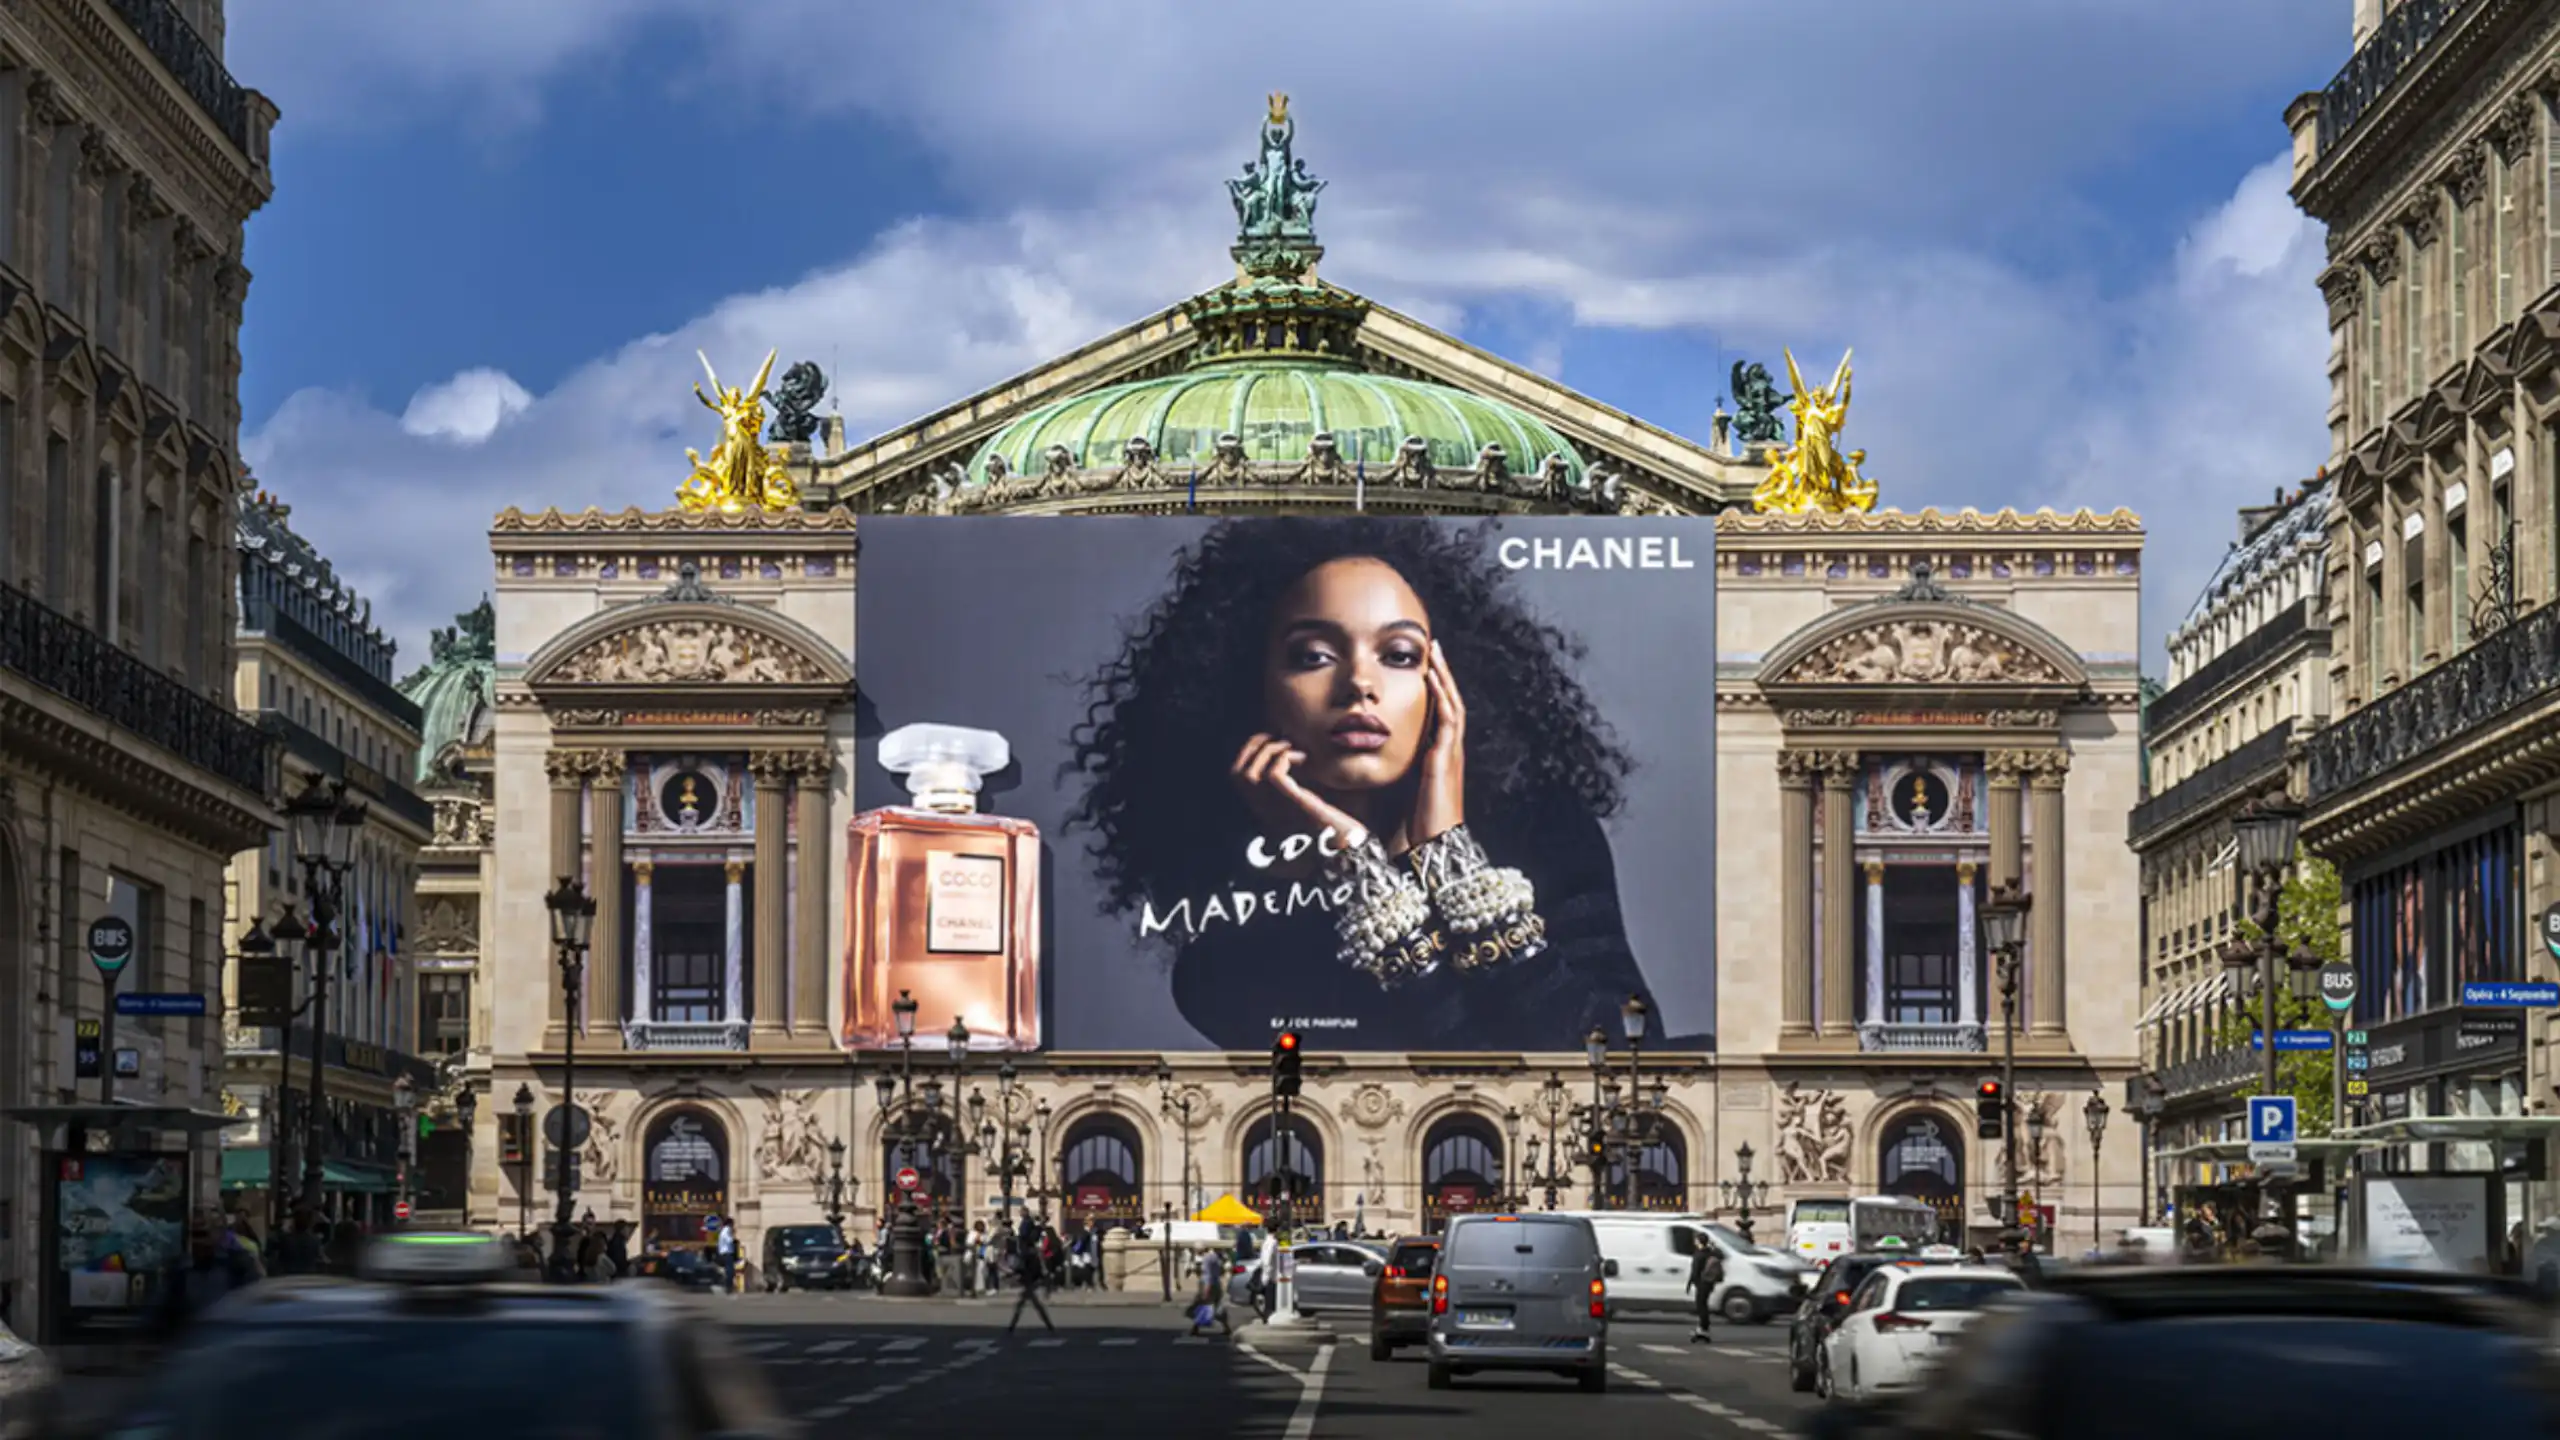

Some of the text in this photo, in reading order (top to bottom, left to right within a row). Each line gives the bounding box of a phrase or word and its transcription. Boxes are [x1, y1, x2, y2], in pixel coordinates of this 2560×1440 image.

[1499, 537, 1694, 569] CHANEL
[939, 870, 993, 888] COCO
[2322, 972, 2354, 989] BUS
[2466, 988, 2493, 1002] Opéra
[1295, 1018, 1309, 1028] DE
[2261, 1105, 2283, 1136] P
